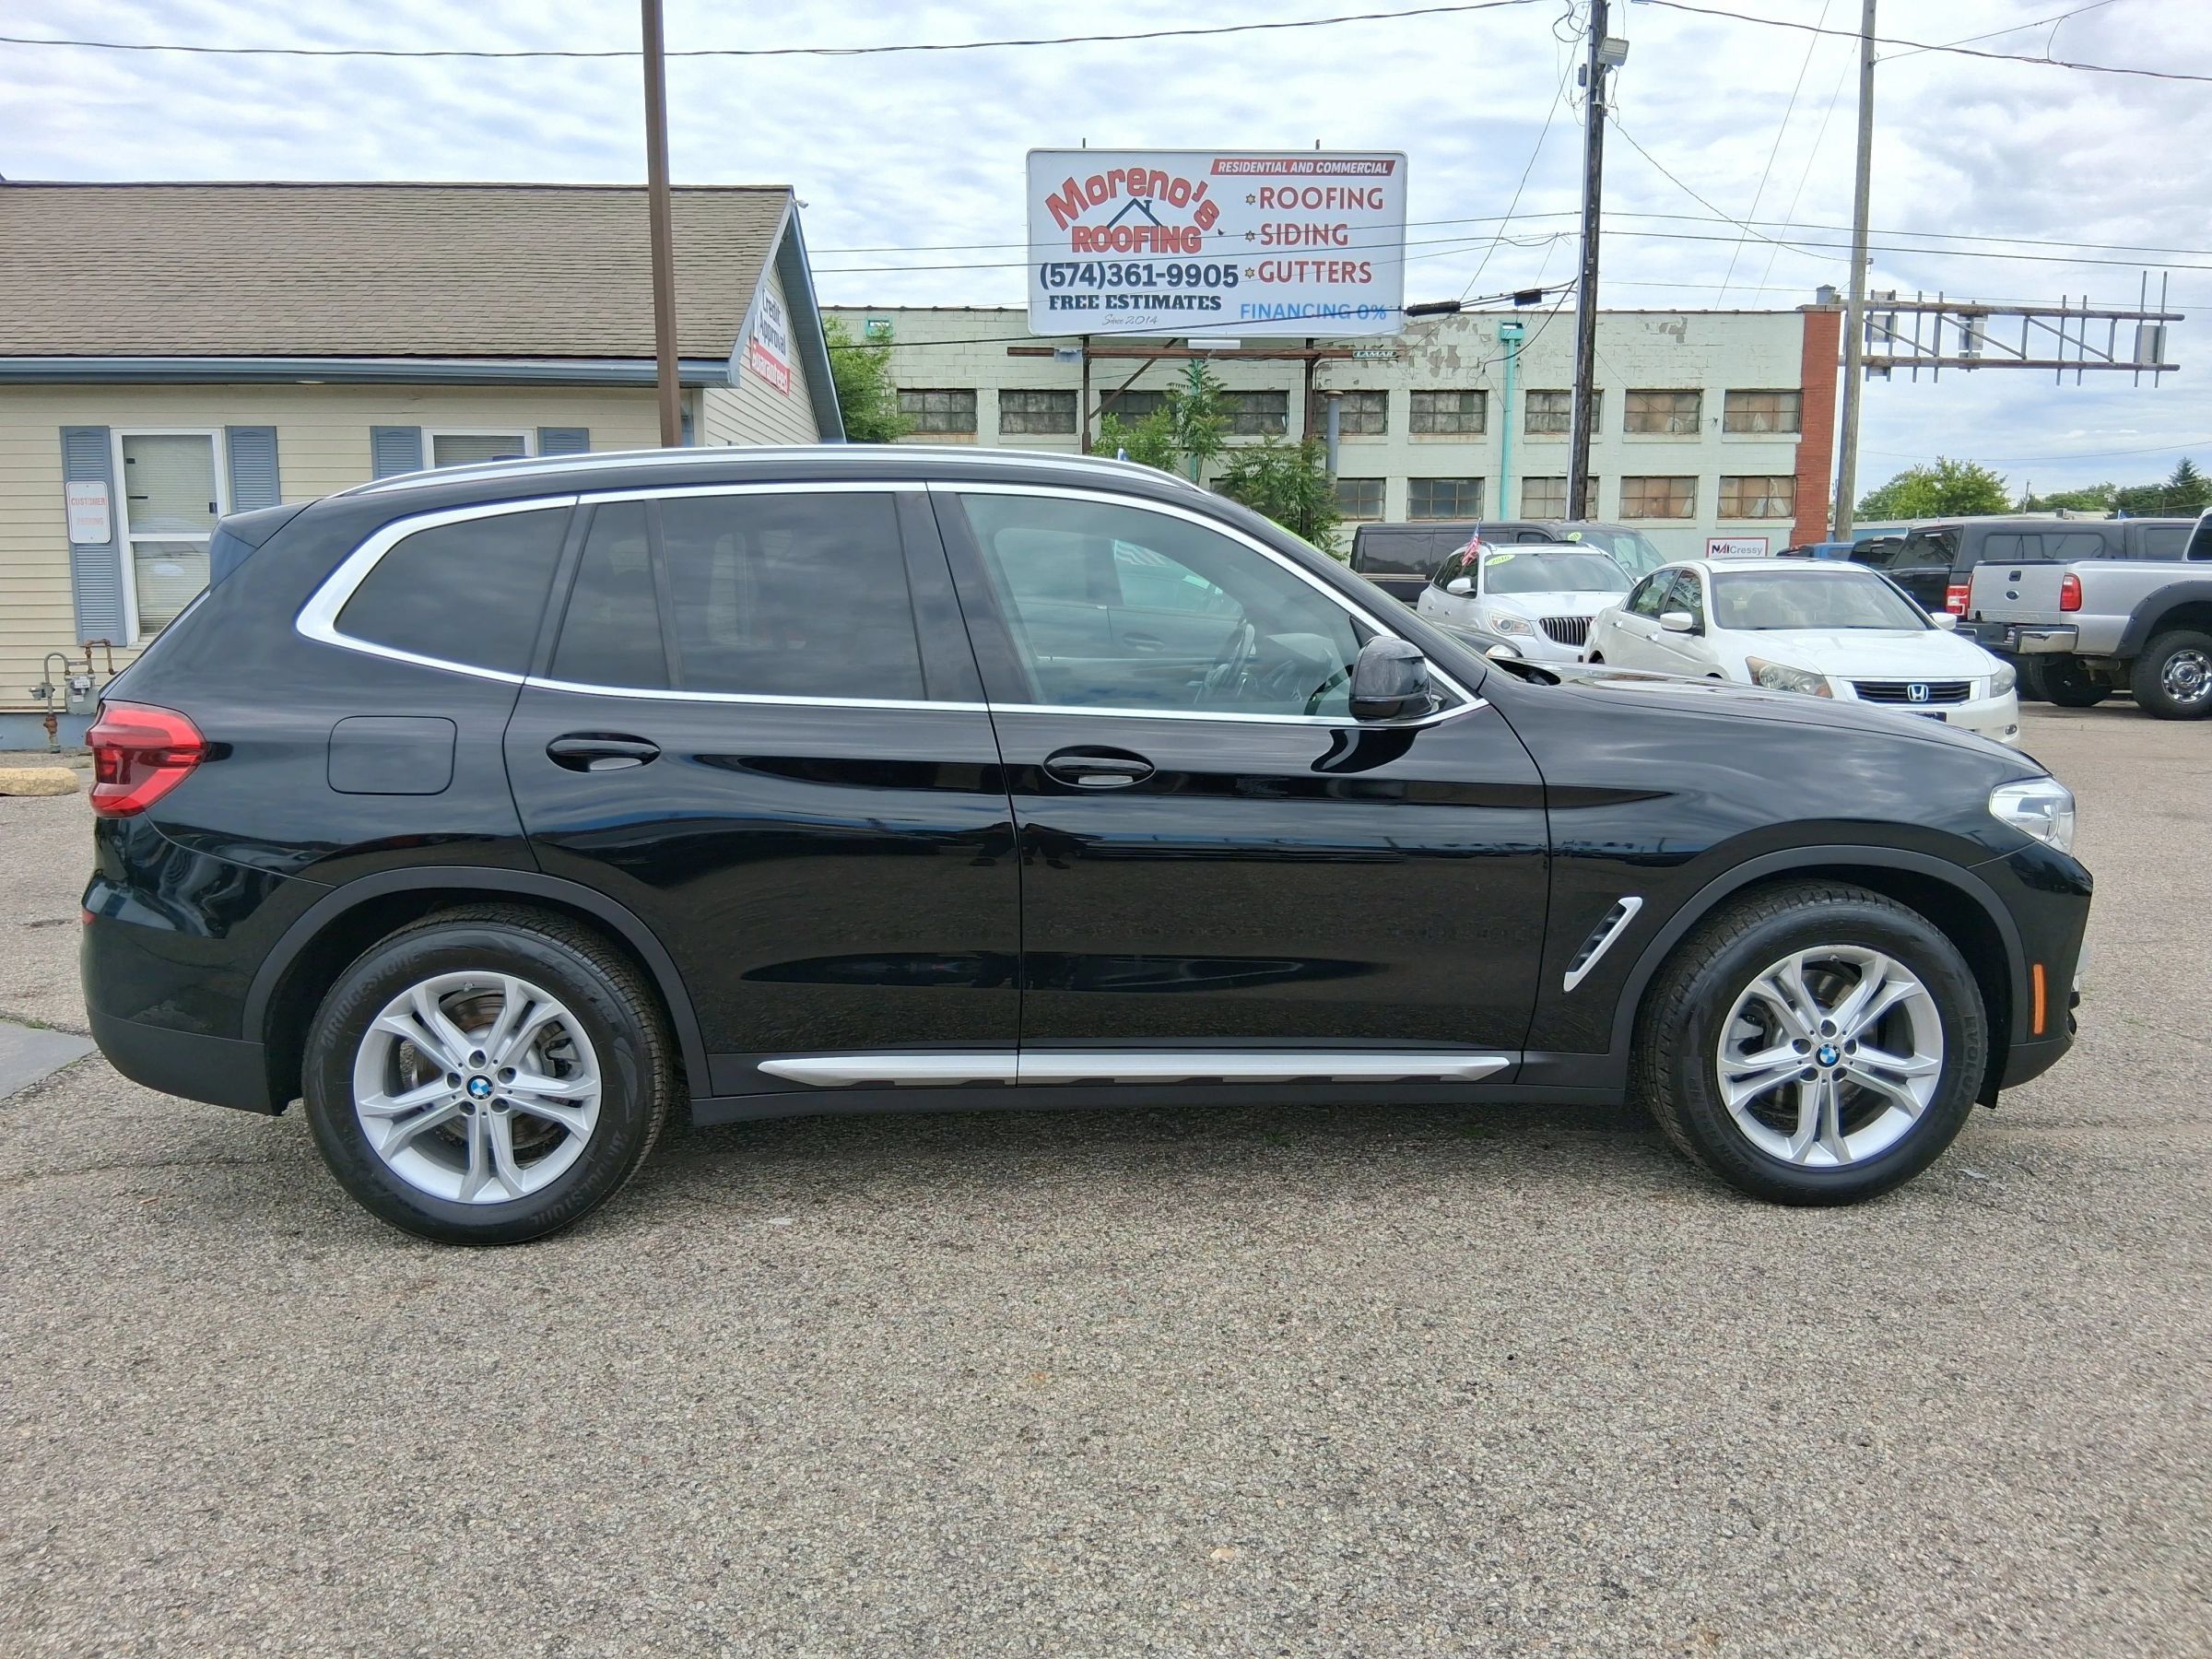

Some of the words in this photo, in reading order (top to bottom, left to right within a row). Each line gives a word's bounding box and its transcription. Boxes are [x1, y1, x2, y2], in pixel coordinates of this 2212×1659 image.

[1218, 161, 1288, 173] RESIDENTIAL
[1290, 162, 1314, 173] AND
[1316, 162, 1388, 174] COMMERCIAL
[1045, 168, 1219, 231] Moreno's
[1259, 186, 1382, 210] ROOFING
[1072, 225, 1202, 253] ROOFING
[1260, 223, 1348, 246] SIDING
[1040, 262, 1239, 290] (574)361-9905
[1258, 261, 1372, 283] GUTTERS
[762, 288, 781, 326] Credit
[1049, 295, 1100, 311] FREE
[1105, 295, 1222, 311] ESTIMATES
[1240, 303, 1350, 320] FINANCING
[1357, 304, 1387, 321] 0%
[1102, 313, 1124, 325] Since
[1124, 315, 1159, 325] 2014
[759, 311, 786, 357] Approval
[71, 497, 106, 506] CUSTOMER
